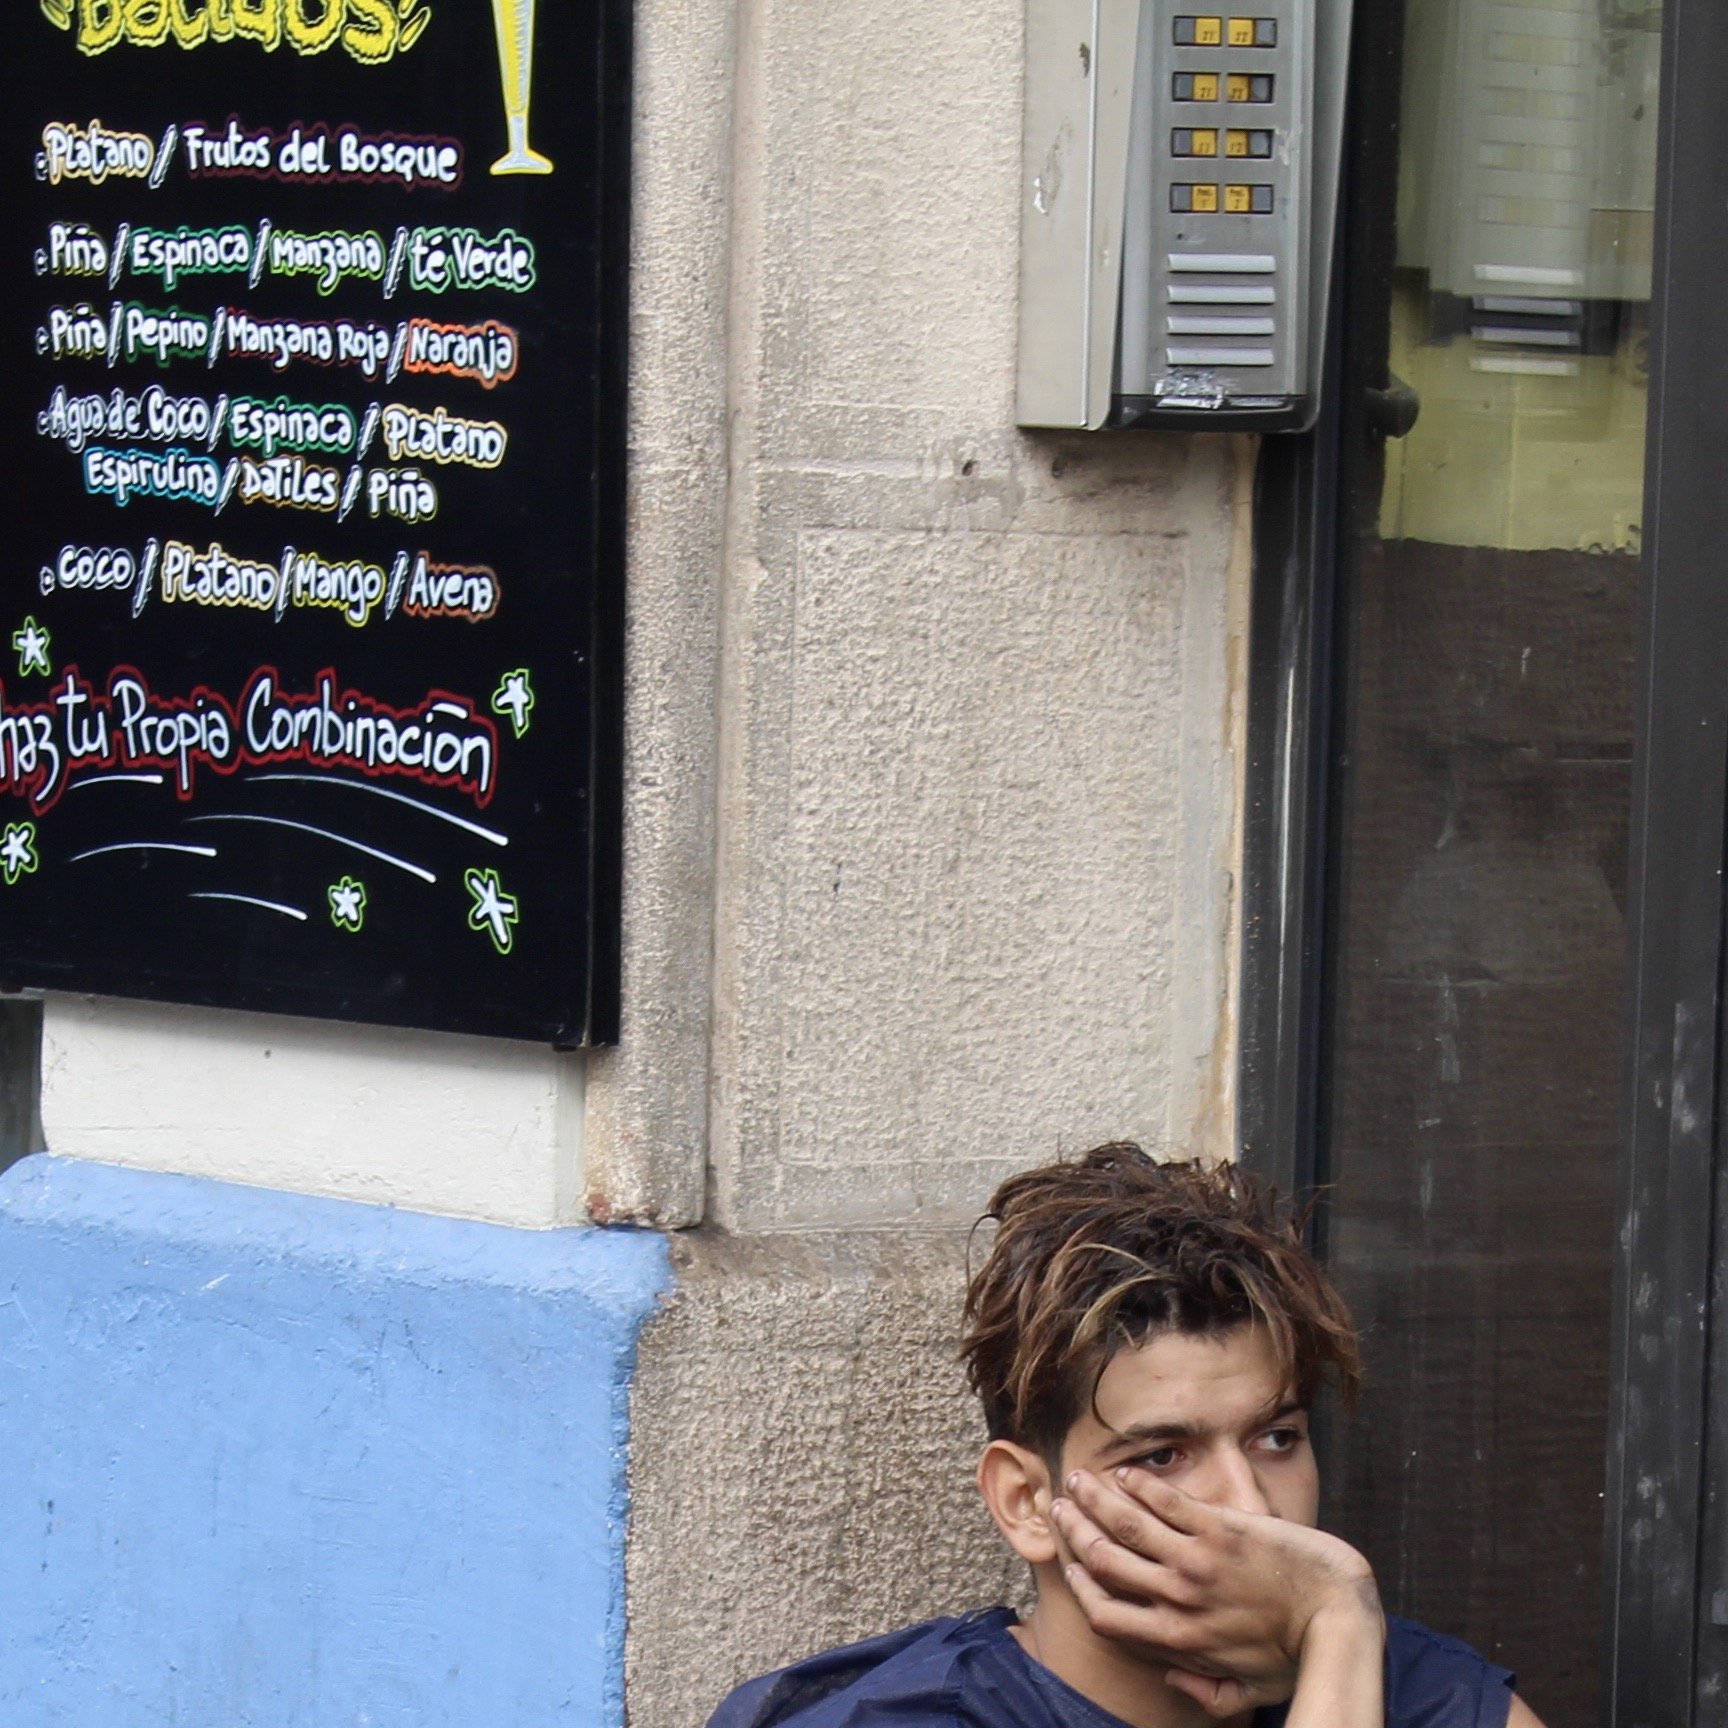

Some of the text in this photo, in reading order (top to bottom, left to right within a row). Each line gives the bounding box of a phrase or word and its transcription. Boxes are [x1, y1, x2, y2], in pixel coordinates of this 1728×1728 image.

[47, 124, 152, 176] Platano
[183, 120, 271, 170] Frutos
[278, 128, 331, 174] del
[339, 132, 460, 184] Bosque
[49, 223, 108, 273] Piña
[132, 231, 250, 285] Espinaca
[272, 235, 382, 289] Manzana
[410, 233, 447, 283] té
[451, 235, 530, 285] Verde
[49, 305, 108, 354] Piña
[125, 307, 209, 362] Pepino
[227, 314, 333, 369] Manzana
[336, 322, 390, 377] Roja
[409, 325, 514, 380] Naranja
[50, 390, 106, 450] Agua
[108, 390, 140, 434] de
[147, 389, 209, 438] Coco
[230, 401, 353, 454] Espinaca
[385, 408, 505, 464] Platano
[87, 450, 220, 502] Espirulina
[370, 471, 437, 520] Piña
[164, 545, 274, 606] Platano
[295, 557, 383, 619] Mango
[407, 556, 494, 614] Avena
[56, 675, 110, 759] tu
[112, 678, 230, 792] Propia
